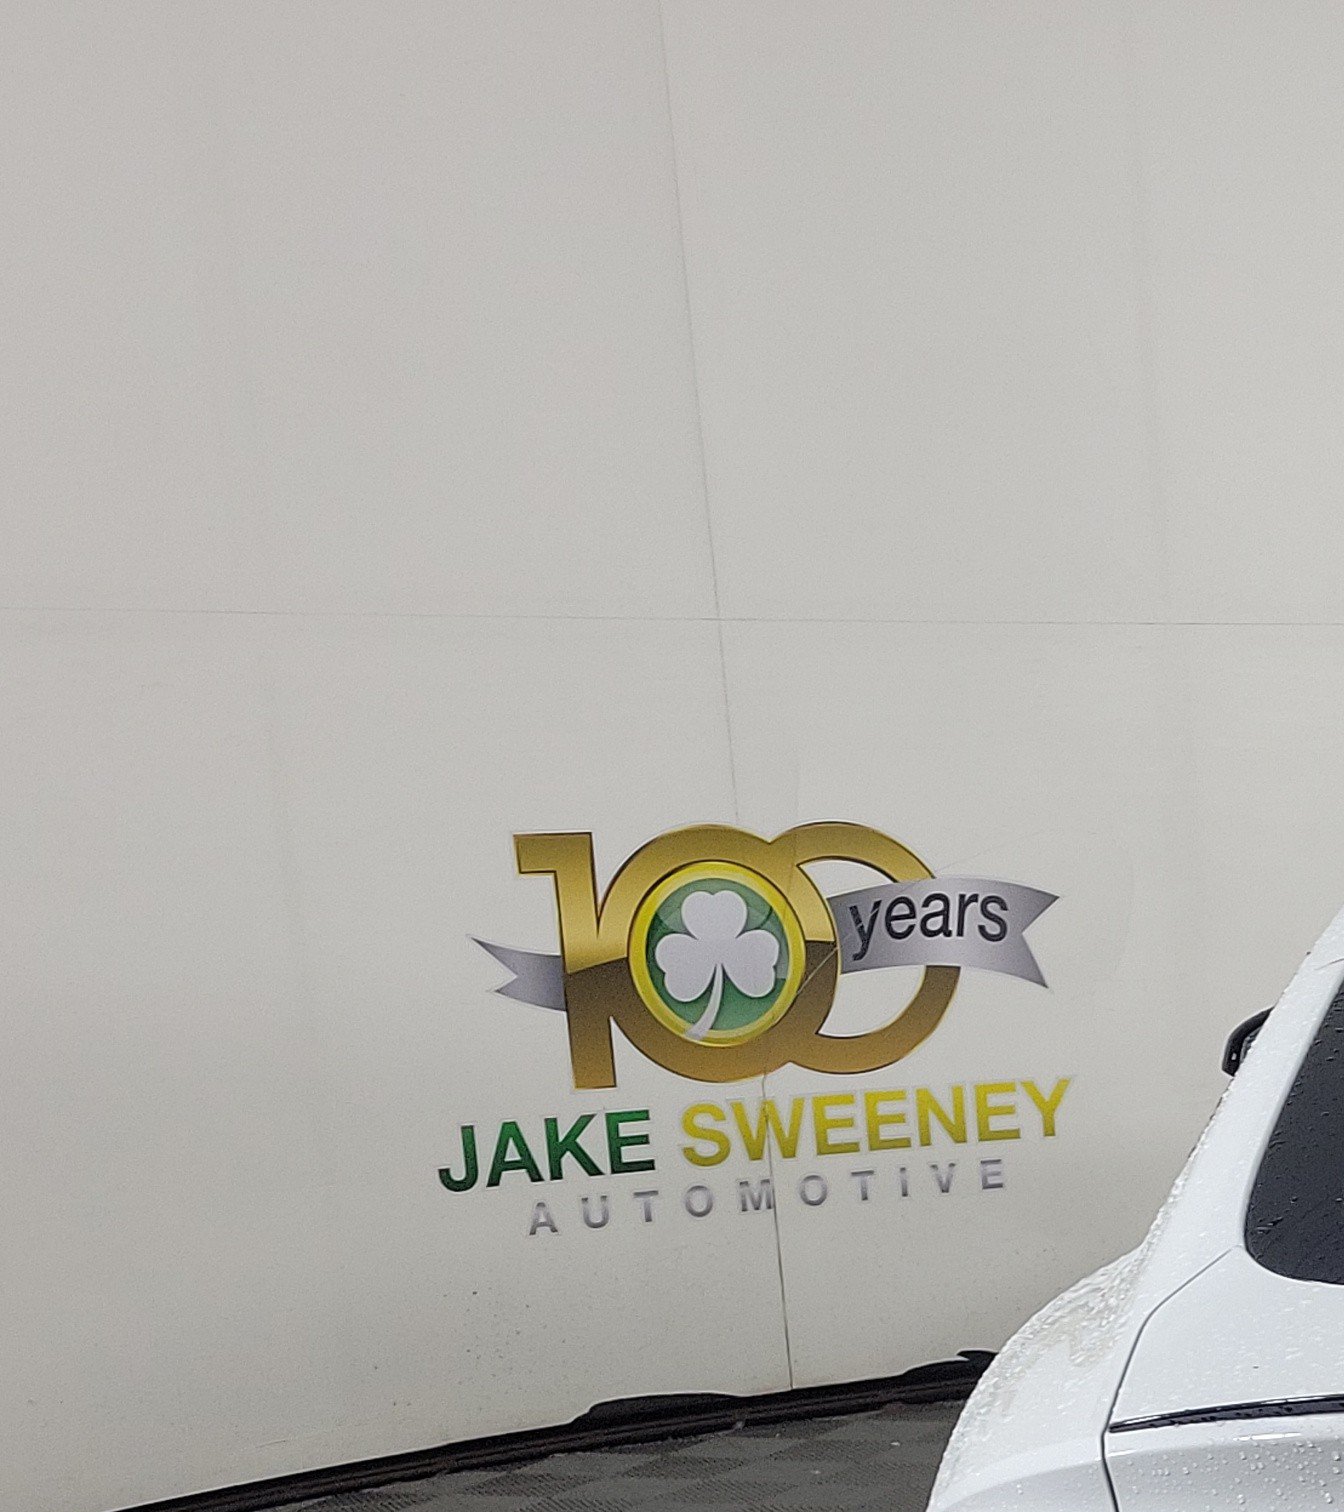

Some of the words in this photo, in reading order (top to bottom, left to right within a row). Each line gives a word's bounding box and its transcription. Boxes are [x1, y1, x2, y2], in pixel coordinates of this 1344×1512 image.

[513, 821, 961, 1090] 100
[847, 891, 1010, 962] years
[437, 1109, 656, 1193] JAKE
[680, 1077, 1072, 1168] SWEENEY
[527, 1157, 1006, 1236] AUTOMOTIVE
